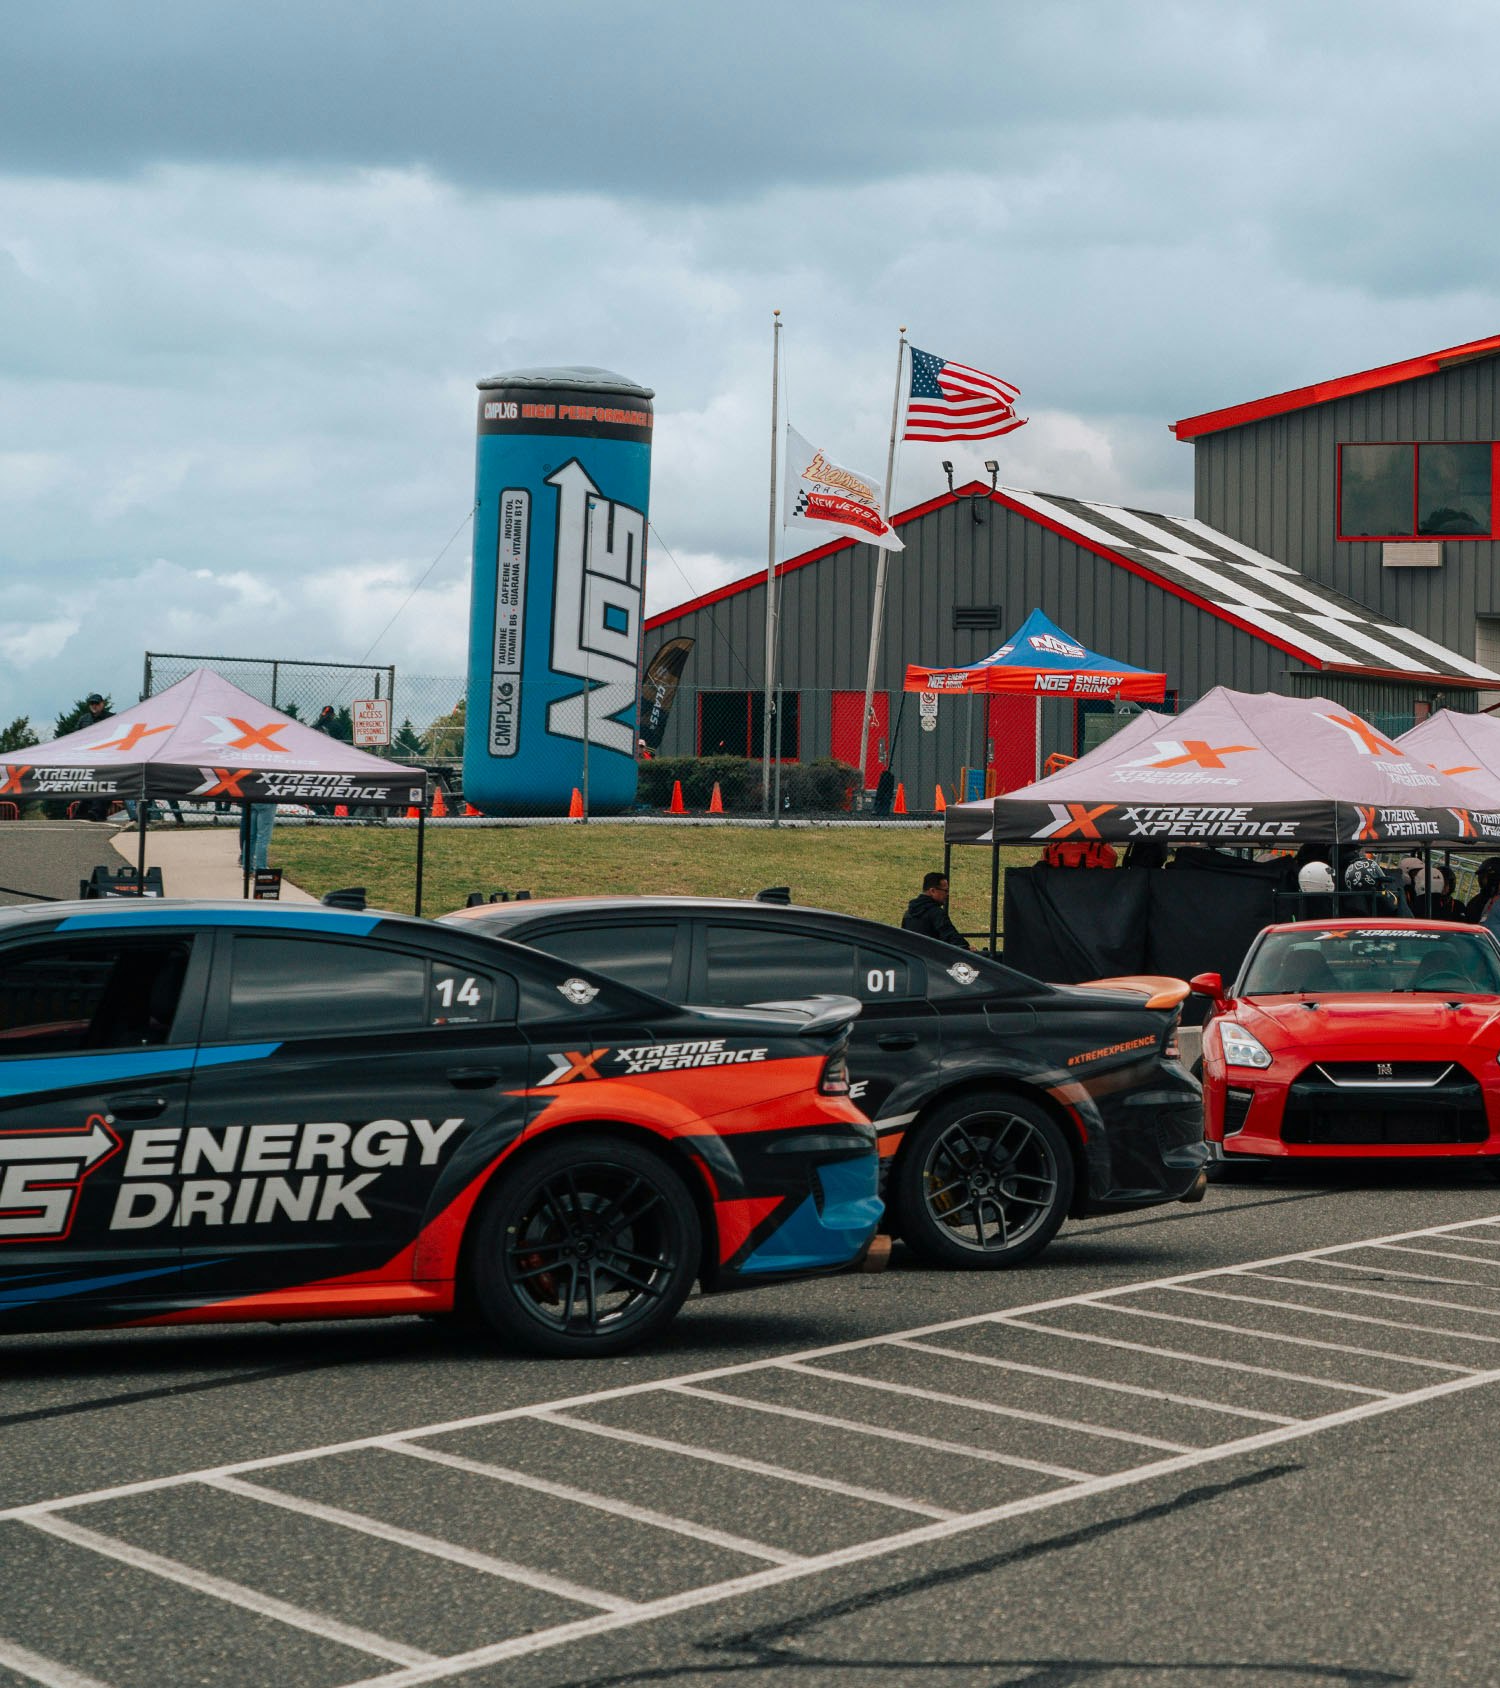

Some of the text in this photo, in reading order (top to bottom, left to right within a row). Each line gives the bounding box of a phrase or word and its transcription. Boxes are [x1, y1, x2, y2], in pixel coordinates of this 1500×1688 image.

[521, 403, 556, 418] HIGH
[810, 497, 887, 529] NEW JERSEY
[498, 499, 514, 665] TAURINE CAFFEINE INOSITOL
[507, 499, 523, 665] VITAMIN B6 GUARANA VITAMIN B12
[544, 457, 645, 758] NOS
[1028, 633, 1086, 656] NOS
[1034, 674, 1074, 691] NOS
[1073, 683, 1111, 694] DRINK
[1075, 675, 1124, 686] ENERGY
[366, 702, 374, 710] NO
[494, 682, 514, 747] CMPLX6
[32, 768, 95, 781] XTREME
[256, 773, 356, 786] XTREME
[1110, 770, 1210, 779] XTREME
[1112, 777, 1243, 786] XPERIENCE
[34, 780, 118, 793] XPERIENCE
[264, 784, 391, 800] XPERIENCE
[1119, 808, 1254, 822] XTREME
[1379, 809, 1420, 822] XTREME
[1128, 821, 1301, 837] XPERIENCE
[1385, 821, 1440, 837] XPERIENCE
[867, 969, 895, 993] 01
[435, 978, 480, 1008] 14
[614, 1039, 726, 1062] XTREME
[1067, 1035, 1157, 1066] #XTREMEXPERIENCE
[624, 1048, 769, 1074] XPERIENCE
[123, 1118, 465, 1178] ENERGY
[109, 1172, 382, 1231] DRINK
